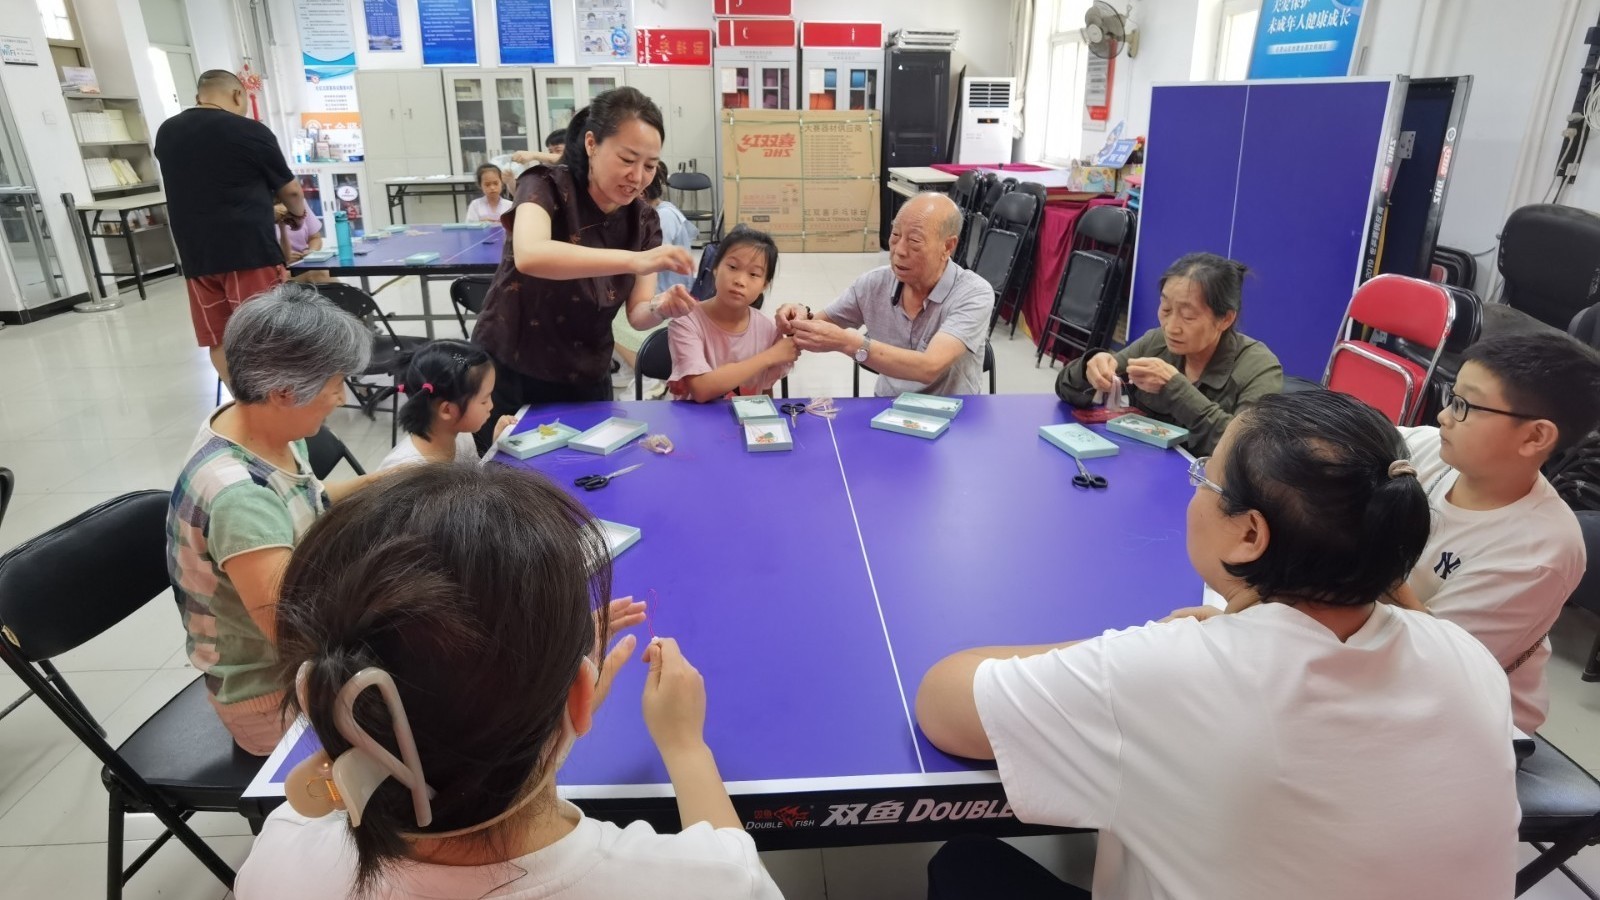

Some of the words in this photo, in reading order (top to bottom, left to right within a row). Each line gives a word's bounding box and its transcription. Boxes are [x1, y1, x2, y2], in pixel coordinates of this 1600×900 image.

[1268, 8, 1351, 34] 未成年人健康成长
[739, 133, 796, 149] 红双喜
[763, 148, 794, 157] DHS
[1433, 180, 1445, 205] DHS
[1365, 258, 1373, 279] 2019
[820, 800, 906, 827] 双鱼
[745, 821, 783, 830] DOUBLE
[795, 819, 815, 828] FISH
